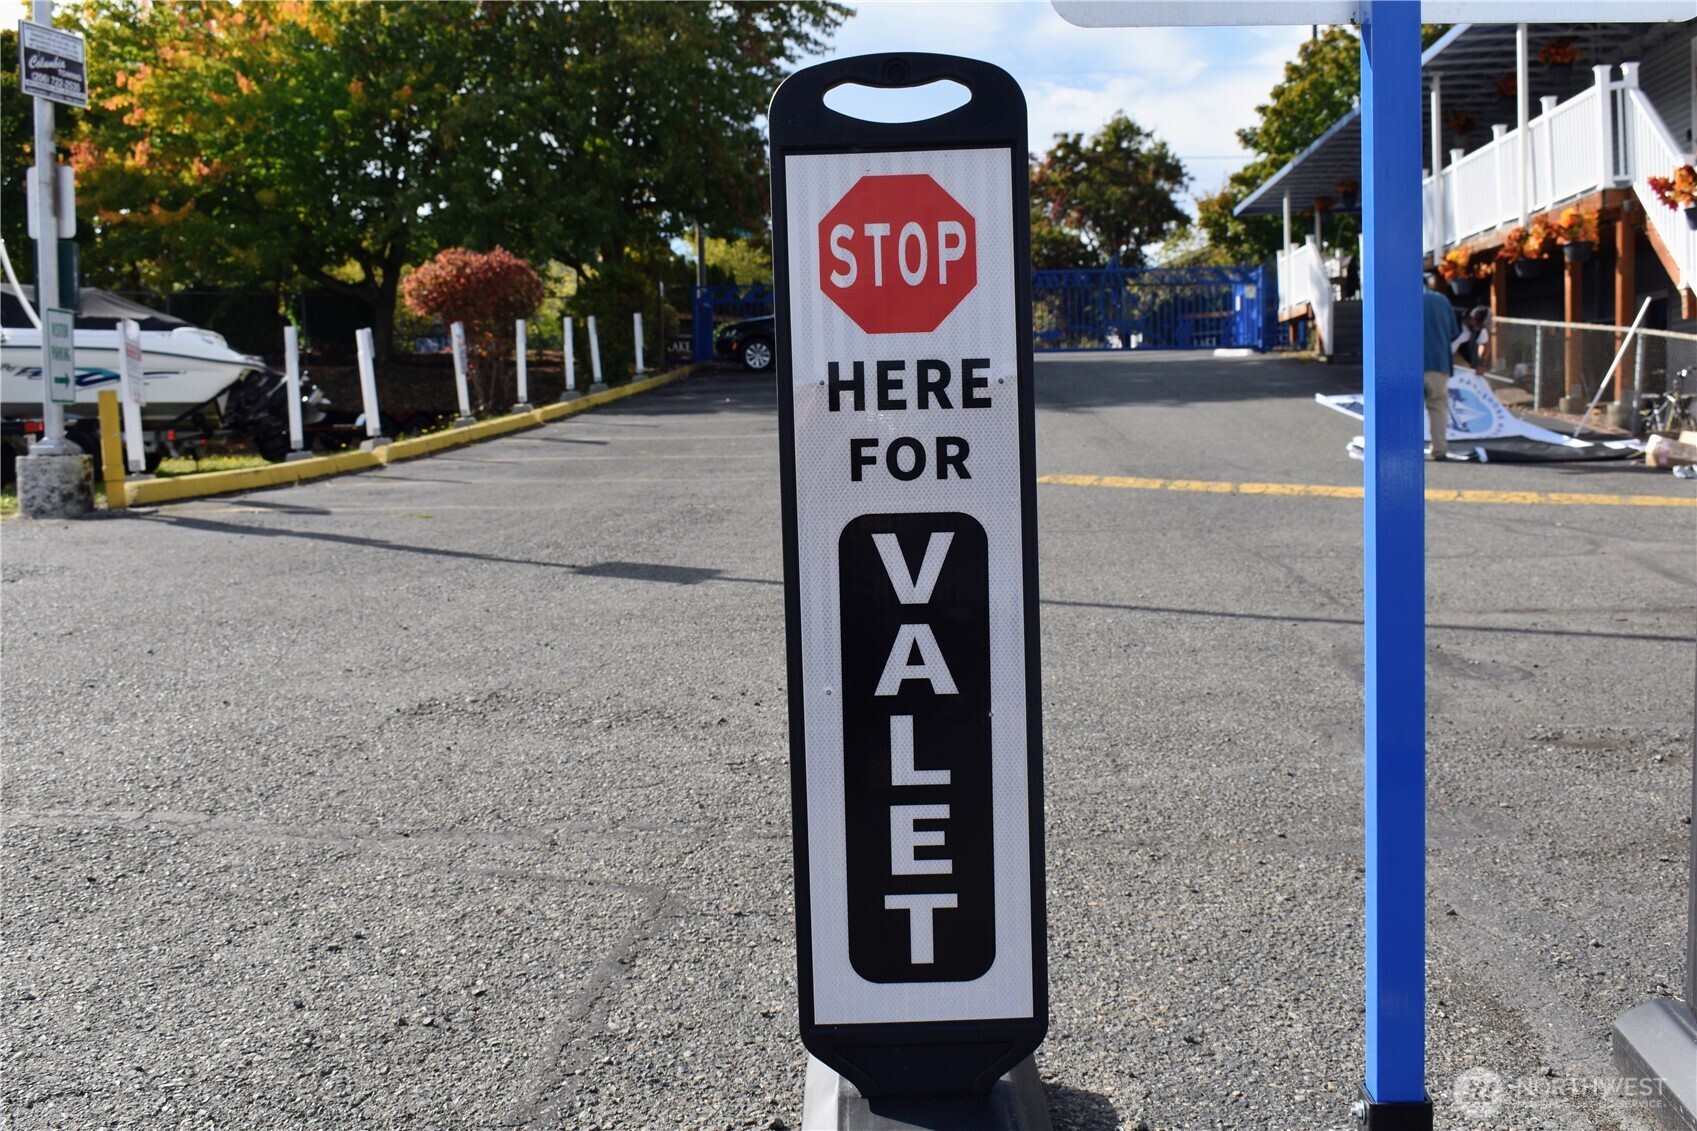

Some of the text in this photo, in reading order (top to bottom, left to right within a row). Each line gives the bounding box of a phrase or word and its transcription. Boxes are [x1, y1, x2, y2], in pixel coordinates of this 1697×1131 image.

[829, 220, 967, 288] STOP
[828, 358, 992, 412] HERE
[850, 436, 972, 482] FOR
[870, 531, 960, 965] VALET
